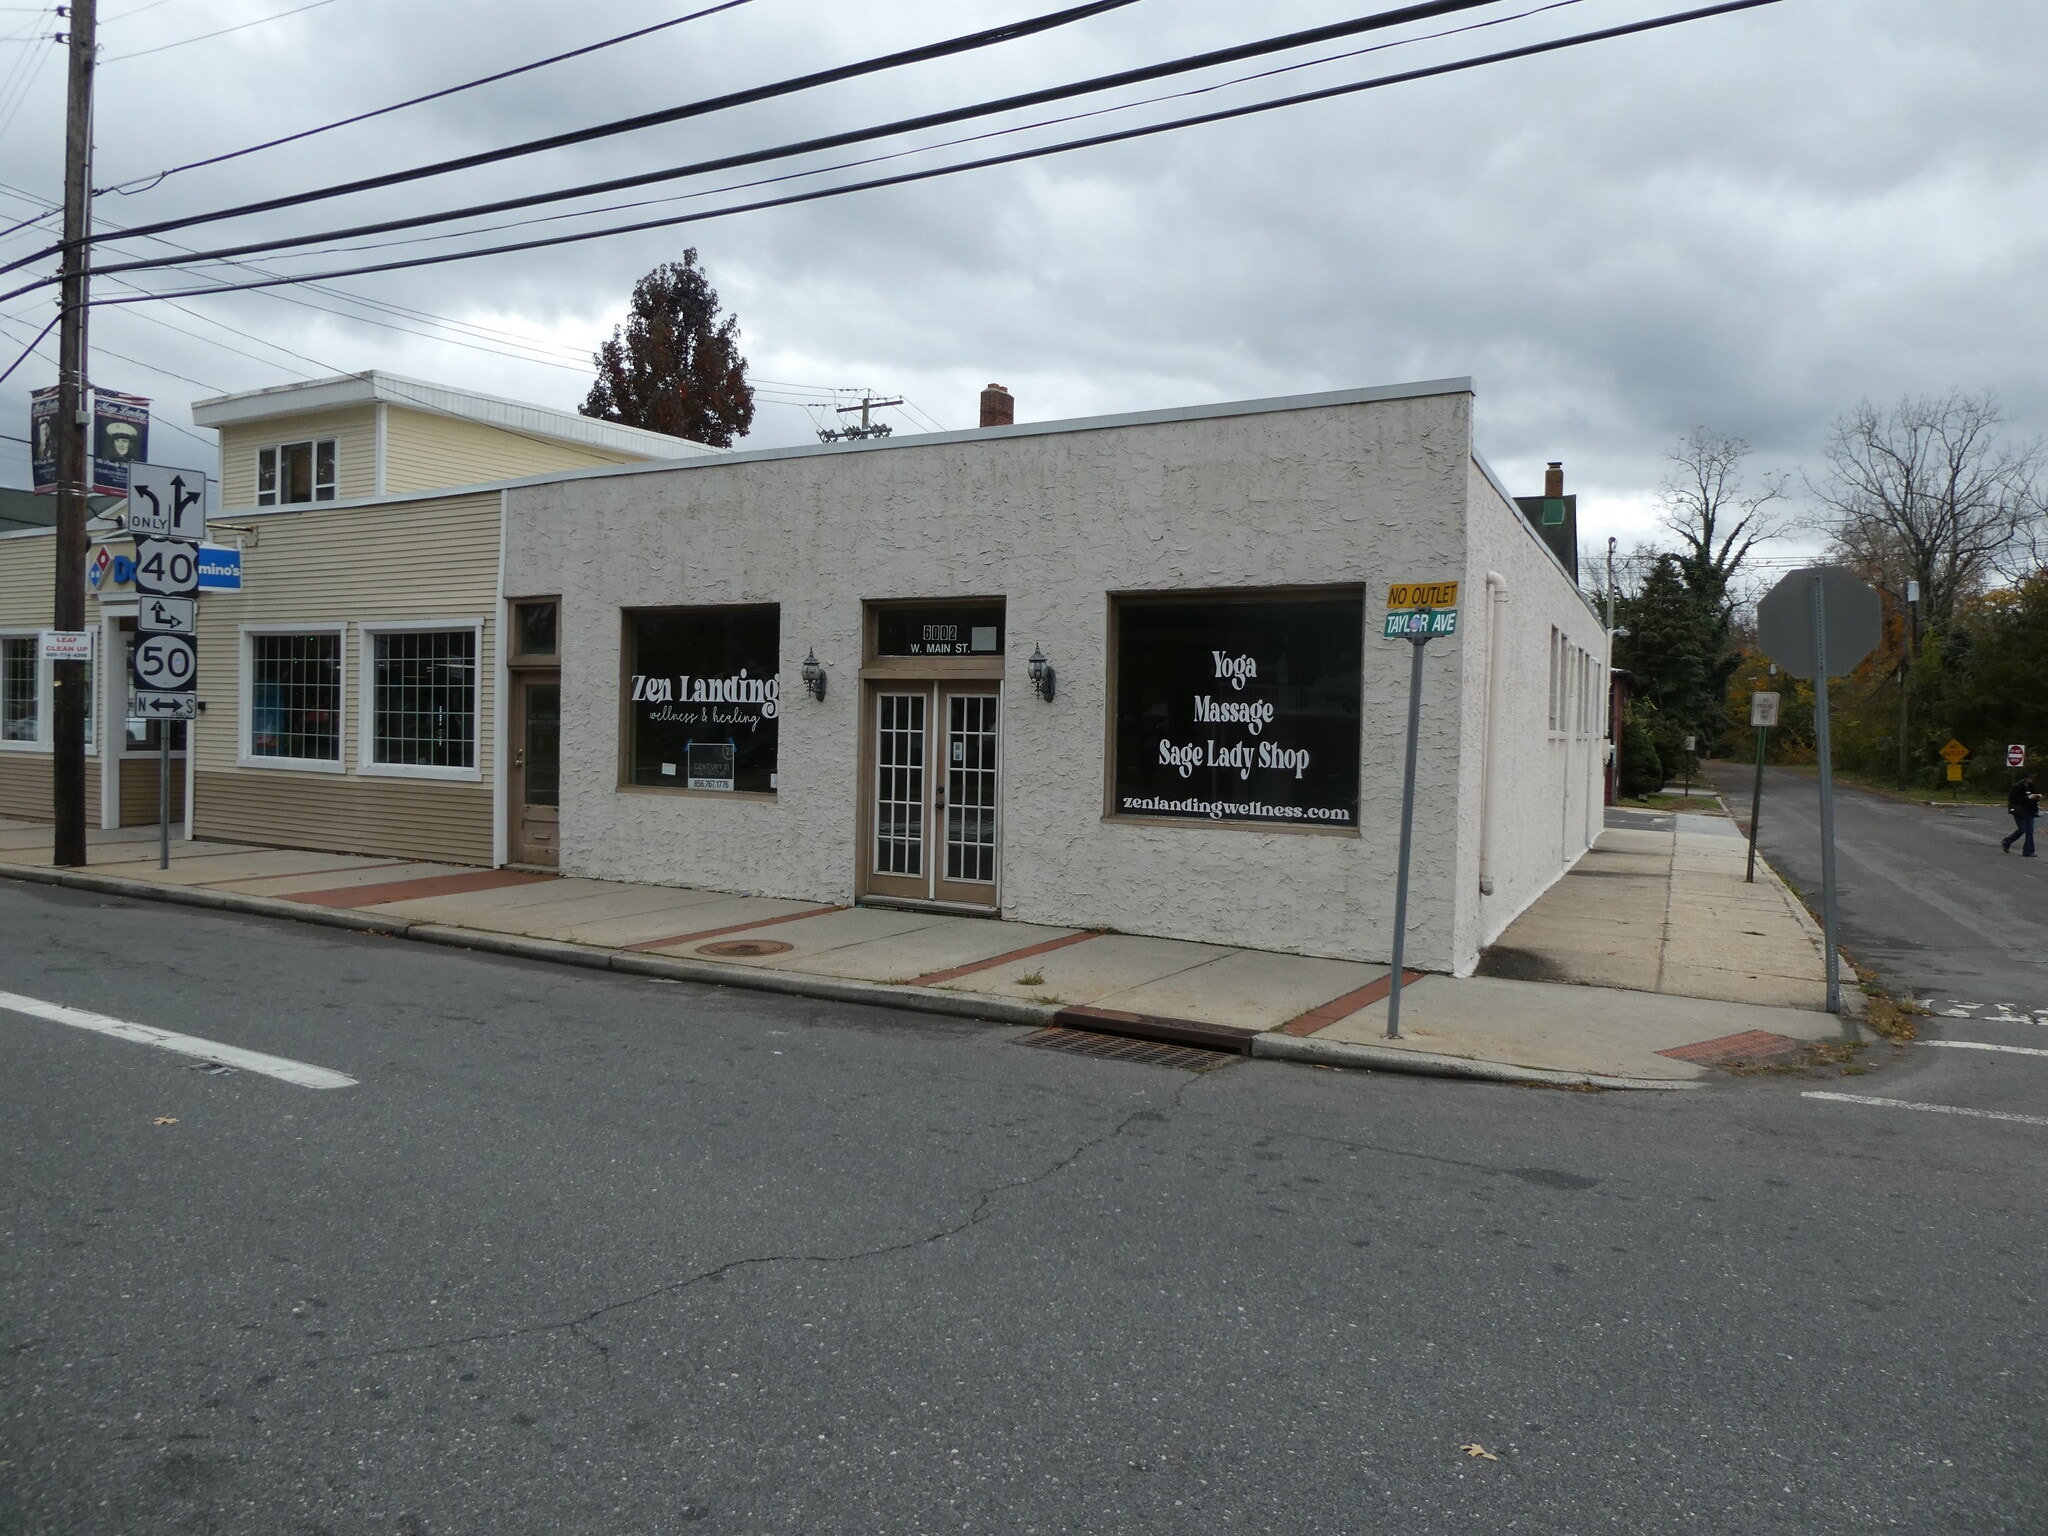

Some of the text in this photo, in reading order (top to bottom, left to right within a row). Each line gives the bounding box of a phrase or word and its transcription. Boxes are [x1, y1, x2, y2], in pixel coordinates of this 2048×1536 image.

[132, 515, 168, 530] ONLY
[140, 553, 191, 584] 40
[1389, 585, 1457, 605] NO OUTLET
[923, 625, 957, 641] 6002
[1432, 613, 1456, 632] AVE
[910, 643, 970, 653] W. MAIN ST.
[143, 646, 191, 678] 50
[1211, 651, 1257, 690] Yoga
[138, 697, 193, 713] N S
[631, 668, 779, 719] Zen Landing
[650, 705, 761, 732] wellness & healing
[1193, 696, 1274, 736] Massage
[1159, 738, 1310, 780] Sage Lady Shop
[1122, 795, 1350, 820] zenlandingwellness.com
